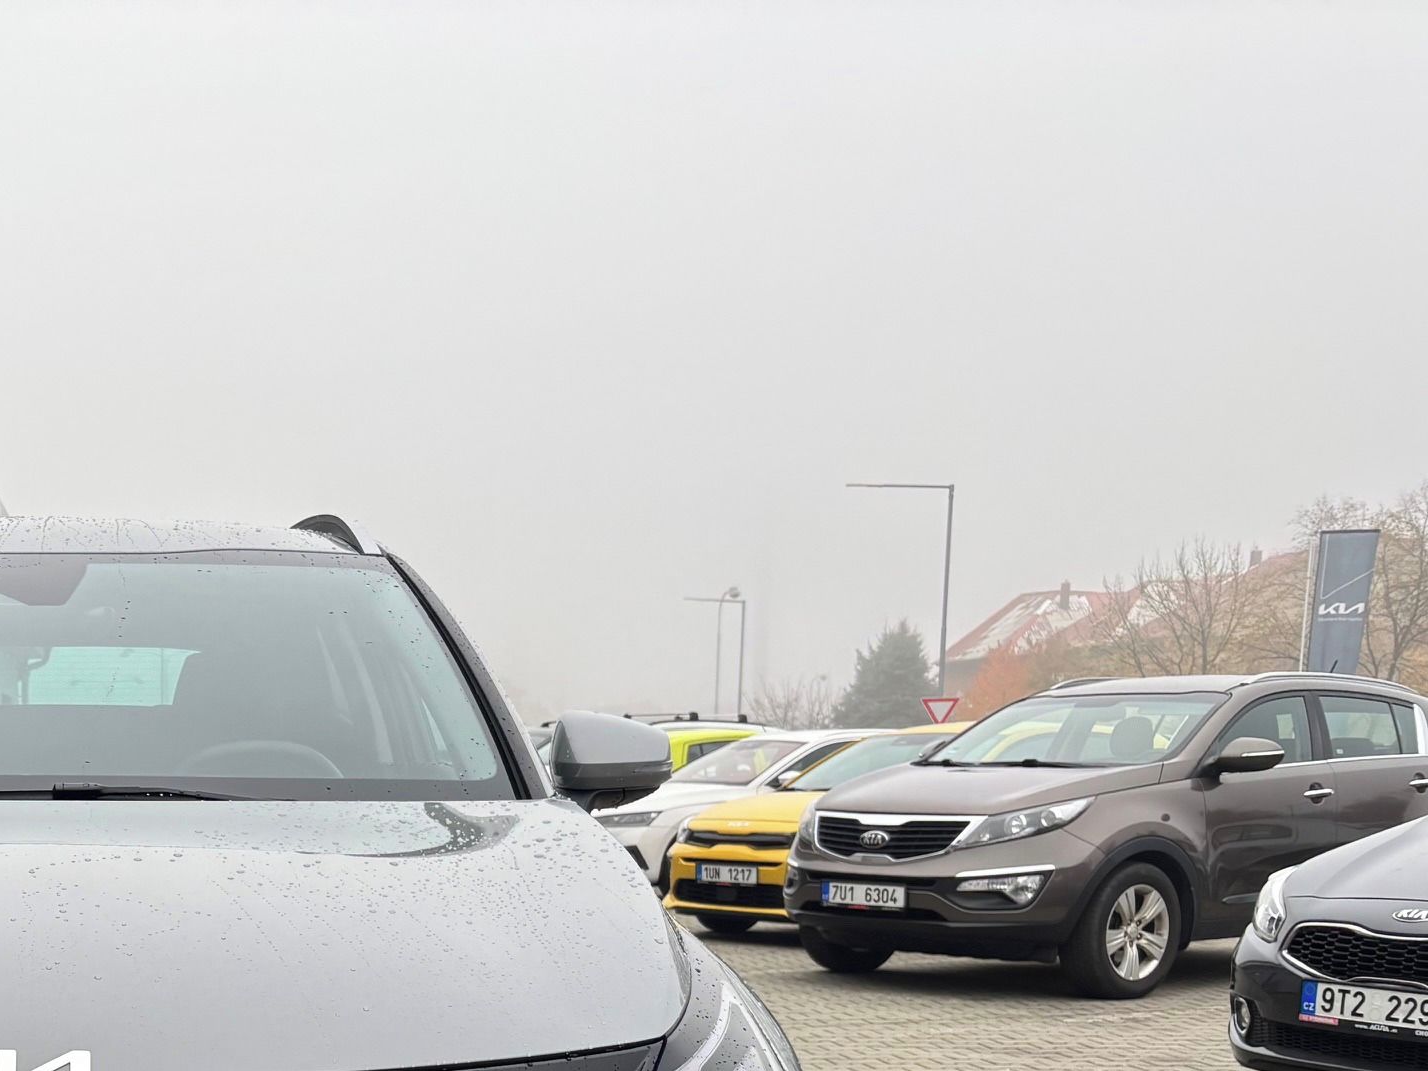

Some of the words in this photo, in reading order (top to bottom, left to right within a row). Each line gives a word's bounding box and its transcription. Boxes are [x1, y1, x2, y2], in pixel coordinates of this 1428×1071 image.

[1318, 603, 1365, 615] KIA
[704, 867, 721, 880] 1UN
[728, 868, 752, 881] 1217
[832, 885, 854, 901] 7U1
[865, 887, 897, 904] 6304
[1397, 909, 1428, 919] KIA
[1303, 1002, 1314, 1011] CZ
[1321, 987, 1366, 1018] 9T2
